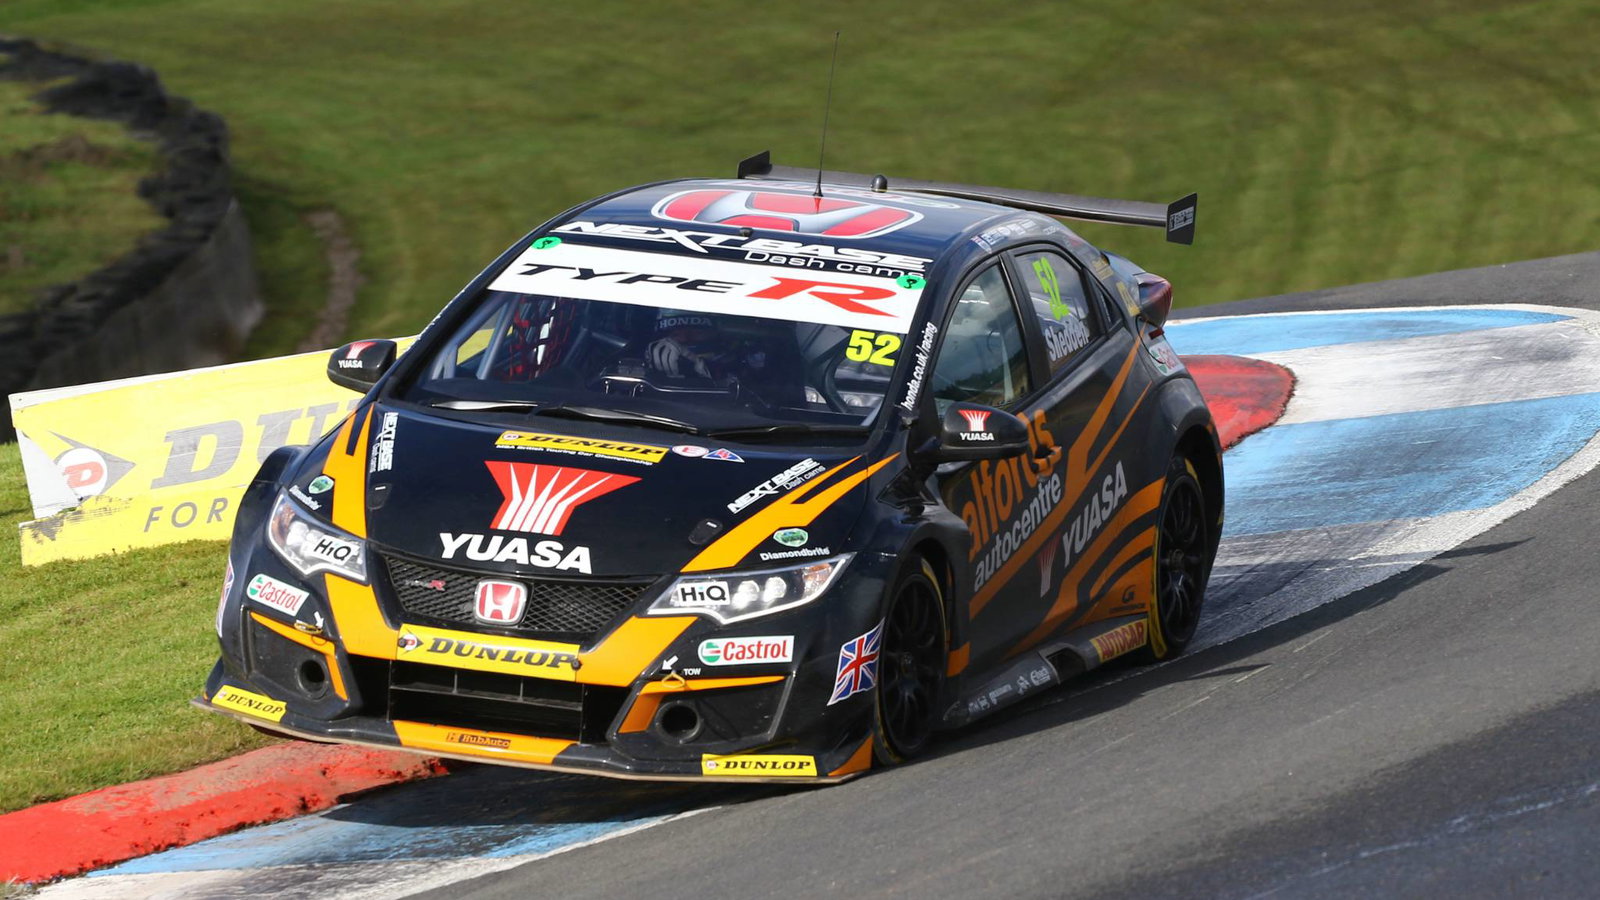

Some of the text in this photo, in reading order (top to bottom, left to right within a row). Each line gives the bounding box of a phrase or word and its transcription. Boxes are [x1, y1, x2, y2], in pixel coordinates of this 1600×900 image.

[744, 251, 925, 279] Dash cams
[517, 263, 900, 318] TYPE R
[659, 317, 712, 328] HONDA
[845, 329, 902, 366] 52
[337, 359, 363, 369] YUASA
[900, 322, 938, 411] honda.co.uk/racing
[527, 435, 665, 455] DUNLOP
[960, 432, 995, 441] YUASA
[782, 475, 806, 491] Dash
[143, 497, 229, 533] FOR
[1062, 460, 1129, 568] YUASA
[973, 472, 1062, 593] autocentre
[314, 538, 351, 560] HiQ
[439, 532, 593, 575] YUASA
[759, 546, 831, 562] Diamondbrite
[258, 581, 302, 612] Castrol
[680, 585, 727, 602] HiQ
[723, 640, 789, 662] Castrol
[1096, 621, 1146, 661] AUTOCAR
[427, 637, 578, 669] DUNLOP
[683, 668, 701, 676] TOW
[226, 693, 284, 715] DUNLOP
[462, 734, 510, 748] HubAuto
[723, 760, 811, 770] DUNLOP
